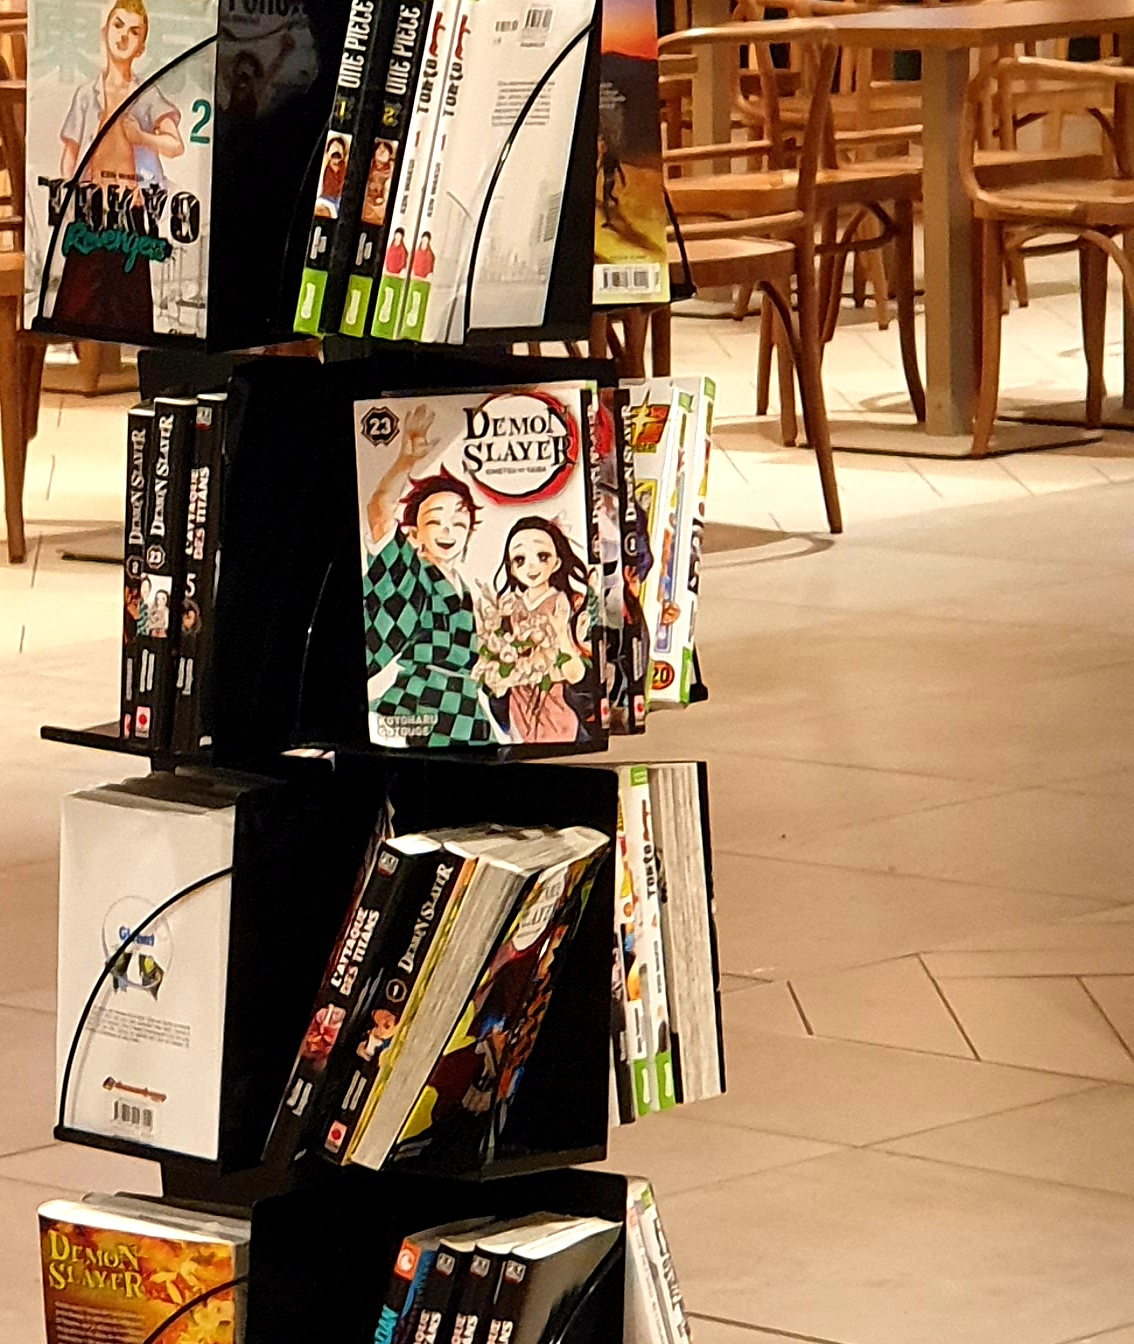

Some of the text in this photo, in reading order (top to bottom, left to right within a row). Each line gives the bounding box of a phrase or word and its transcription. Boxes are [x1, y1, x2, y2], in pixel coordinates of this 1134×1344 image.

[392, 3, 422, 57] PIECE
[338, 51, 366, 90] ONE
[385, 57, 412, 96] ONE
[189, 98, 213, 145] 2
[368, 415, 392, 436] 23
[463, 405, 571, 440] DEMON
[156, 413, 176, 478] SLAYER
[462, 436, 572, 474] SLAYER
[185, 573, 197, 598] 5
[195, 466, 210, 525] TITANS
[398, 918, 431, 974] DEMON
[420, 863, 454, 922] SLAYER
[331, 906, 369, 988] L'ATTAQUE
[339, 909, 380, 996] DES TITANS
[47, 1229, 142, 1272] DEMON
[48, 1261, 143, 1298] SLAYER
